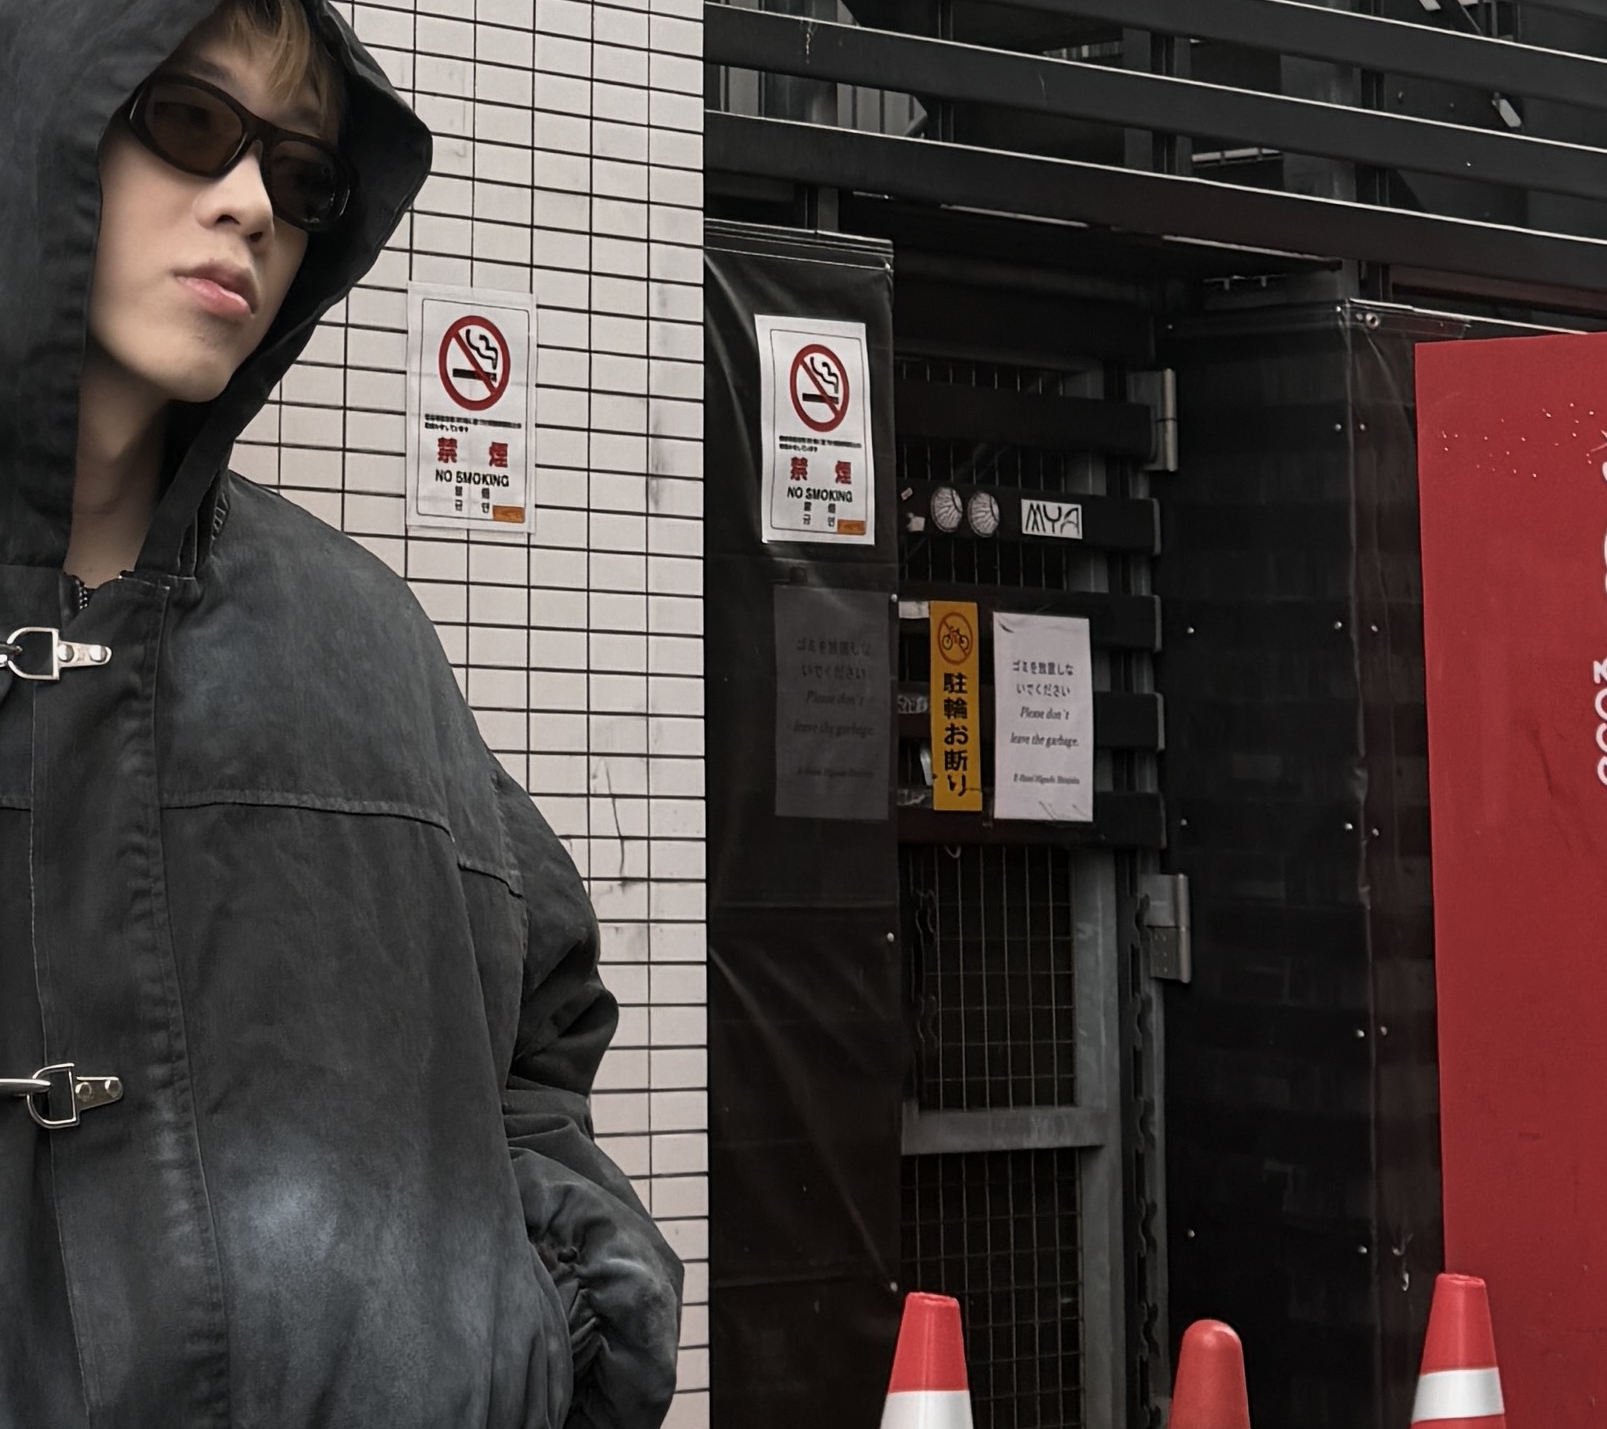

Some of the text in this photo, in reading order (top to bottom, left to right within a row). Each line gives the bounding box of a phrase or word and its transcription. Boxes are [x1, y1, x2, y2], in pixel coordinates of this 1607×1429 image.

[434, 469, 510, 488] NO SMOKING
[786, 486, 854, 503] NO SMOKING
[1019, 705, 1044, 720] Please
[942, 670, 970, 797] 駐輪お断り
